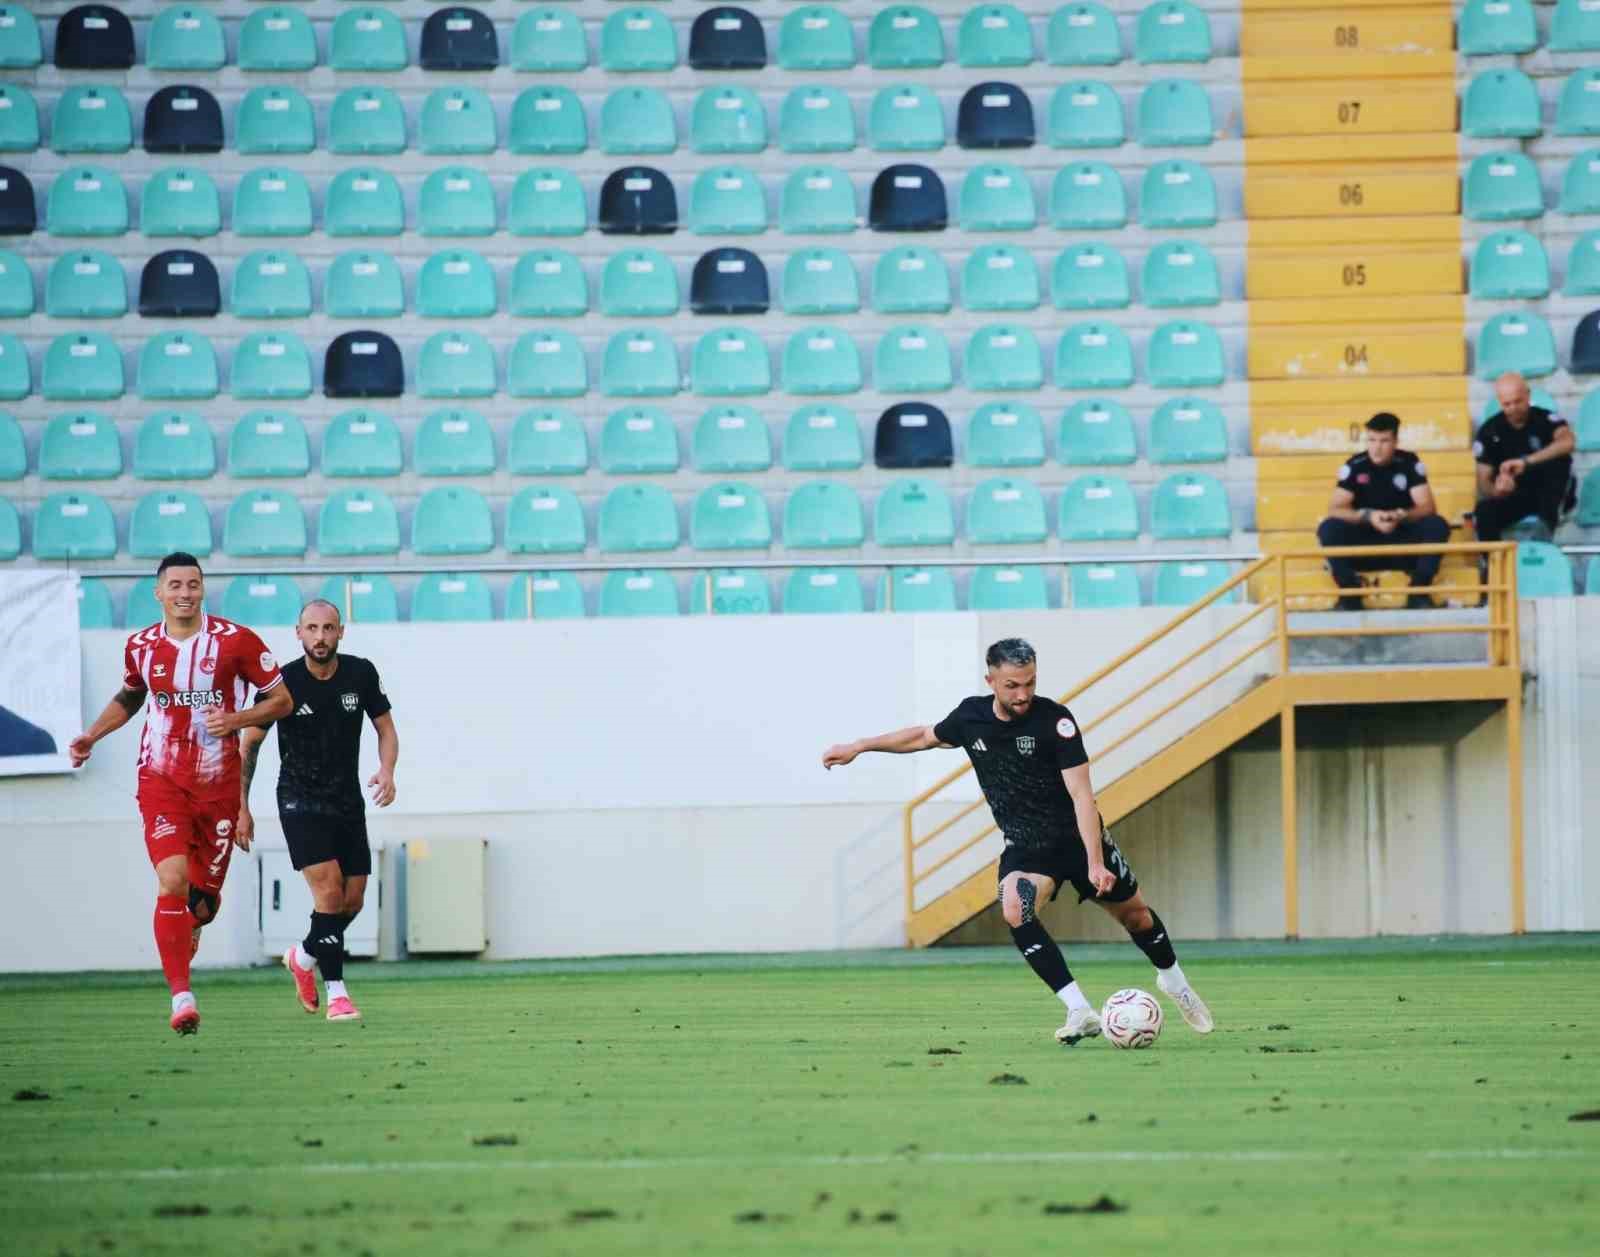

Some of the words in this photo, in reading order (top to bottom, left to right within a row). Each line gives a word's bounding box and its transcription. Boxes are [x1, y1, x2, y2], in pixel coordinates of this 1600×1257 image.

[1335, 25, 1358, 47] 08
[1338, 102, 1361, 124] 07
[1339, 183, 1363, 206] 06
[1342, 264, 1366, 286] 05
[211, 838, 230, 865] 7
